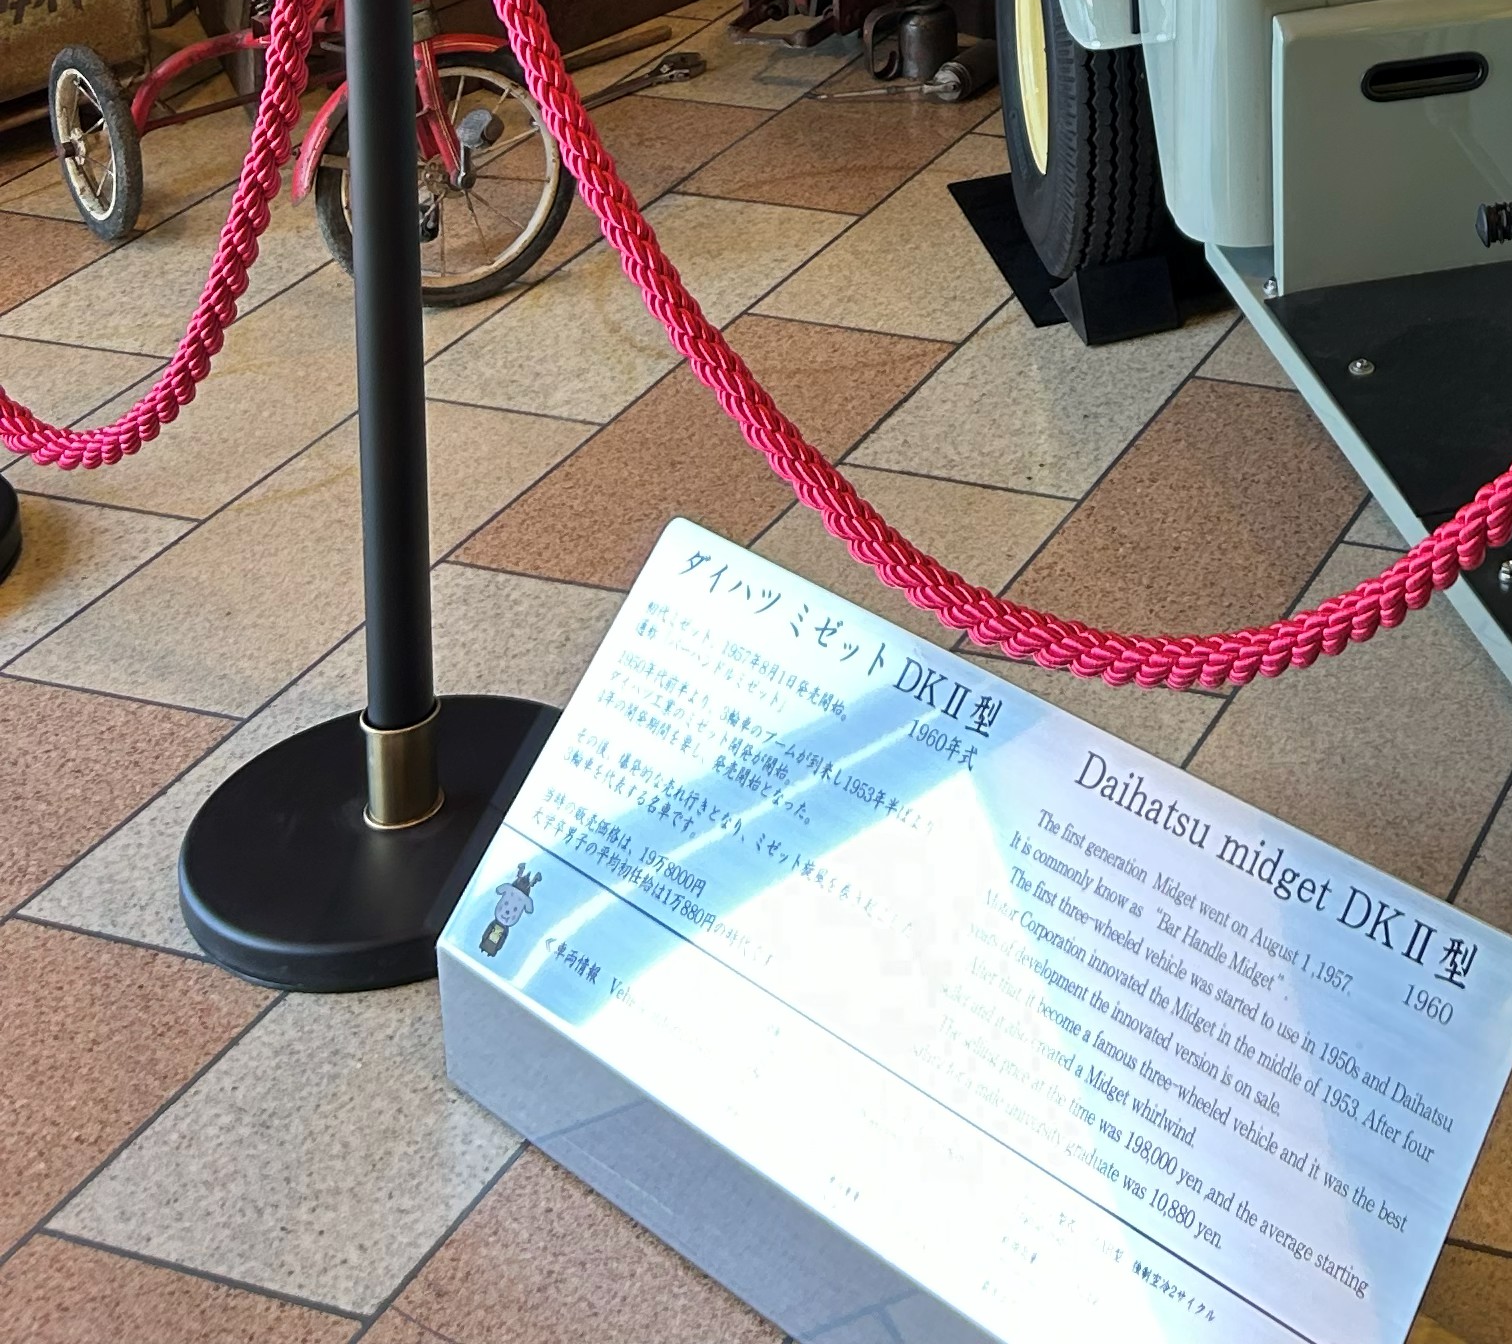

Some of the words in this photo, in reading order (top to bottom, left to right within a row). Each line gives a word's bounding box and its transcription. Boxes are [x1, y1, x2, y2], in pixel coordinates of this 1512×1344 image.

[677, 549, 782, 615] ダイハツ
[788, 602, 886, 677] ミゼット
[906, 718, 978, 772] 1960年式
[1008, 829, 1022, 850] It
[1019, 835, 1033, 856] is
[1031, 847, 1095, 891] commonly
[1092, 875, 1130, 909] know
[1127, 901, 1145, 918] as
[1180, 923, 1228, 964] Handle
[1036, 807, 1061, 835] The
[1059, 821, 1086, 849] first
[1083, 840, 1148, 884] generation
[1150, 870, 1197, 910] Midget
[1198, 900, 1231, 928] went
[1229, 919, 1249, 939] on
[1248, 926, 1300, 966] August
[1073, 749, 1211, 850] Daihatsu
[1214, 833, 1333, 912] midget
[1008, 864, 1032, 893] The
[1030, 879, 1058, 907] first
[1057, 894, 1145, 956] three-wheeled
[1144, 945, 1188, 980] vehicle
[1189, 971, 1214, 996] was
[1213, 987, 1261, 1022] started
[1259, 1009, 1275, 1030] to
[1275, 1020, 1300, 1044] use
[1299, 1029, 1316, 1056] in
[1317, 1041, 1359, 1079] 1950s
[1360, 1070, 1392, 1096] and
[1389, 1080, 1454, 1134] Daihatsu
[1016, 945, 1089, 1002] development
[1088, 989, 1110, 1014] the
[1109, 999, 1174, 1051] innovated
[1174, 1041, 1219, 1080] version
[1218, 1063, 1234, 1086] is
[1233, 1078, 1252, 1100] on
[1252, 1089, 1280, 1118] sale.
[1019, 909, 1087, 963] Corporation
[1086, 948, 1150, 997] innovated
[1147, 984, 1170, 1010] the
[1169, 995, 1217, 1037] Midget
[1215, 1021, 1232, 1047] in
[1232, 1033, 1256, 1060] the
[1255, 1049, 1302, 1086] middle
[1302, 1076, 1323, 1097] of
[1320, 1083, 1360, 1121] 1953.
[1360, 1107, 1402, 1144] After
[1400, 1128, 1435, 1163] four
[1401, 983, 1454, 1026] 1960
[1029, 1039, 1077, 1072] created
[1073, 1063, 1084, 1079] a
[1082, 1063, 1130, 1106] Midget
[1131, 1096, 1197, 1149] whirlwind.
[1036, 995, 1082, 1036] become
[1080, 1028, 1092, 1043] a
[1091, 1029, 1138, 1071] famous
[1138, 1058, 1232, 1126] three-wheeled
[1232, 1116, 1279, 1155] vehicle
[1278, 1146, 1309, 1172] and
[1306, 1156, 1320, 1180] it
[1322, 1170, 1350, 1198] was
[1350, 1185, 1376, 1213] the
[1376, 1198, 1408, 1234] best
[1045, 1083, 1067, 1105] the
[1067, 1097, 1096, 1126] time
[1098, 1117, 1123, 1143] was
[1122, 1130, 1178, 1176] 198,000
[1174, 1167, 1203, 1195] yen
[1234, 1199, 1258, 1227] the
[1258, 1218, 1314, 1261] average
[1313, 1253, 1369, 1299] starting
[1063, 1142, 1120, 1182] graduate
[1121, 1173, 1148, 1200] was
[1147, 1187, 1196, 1229] 10,880
[1192, 1220, 1222, 1250] yen.
